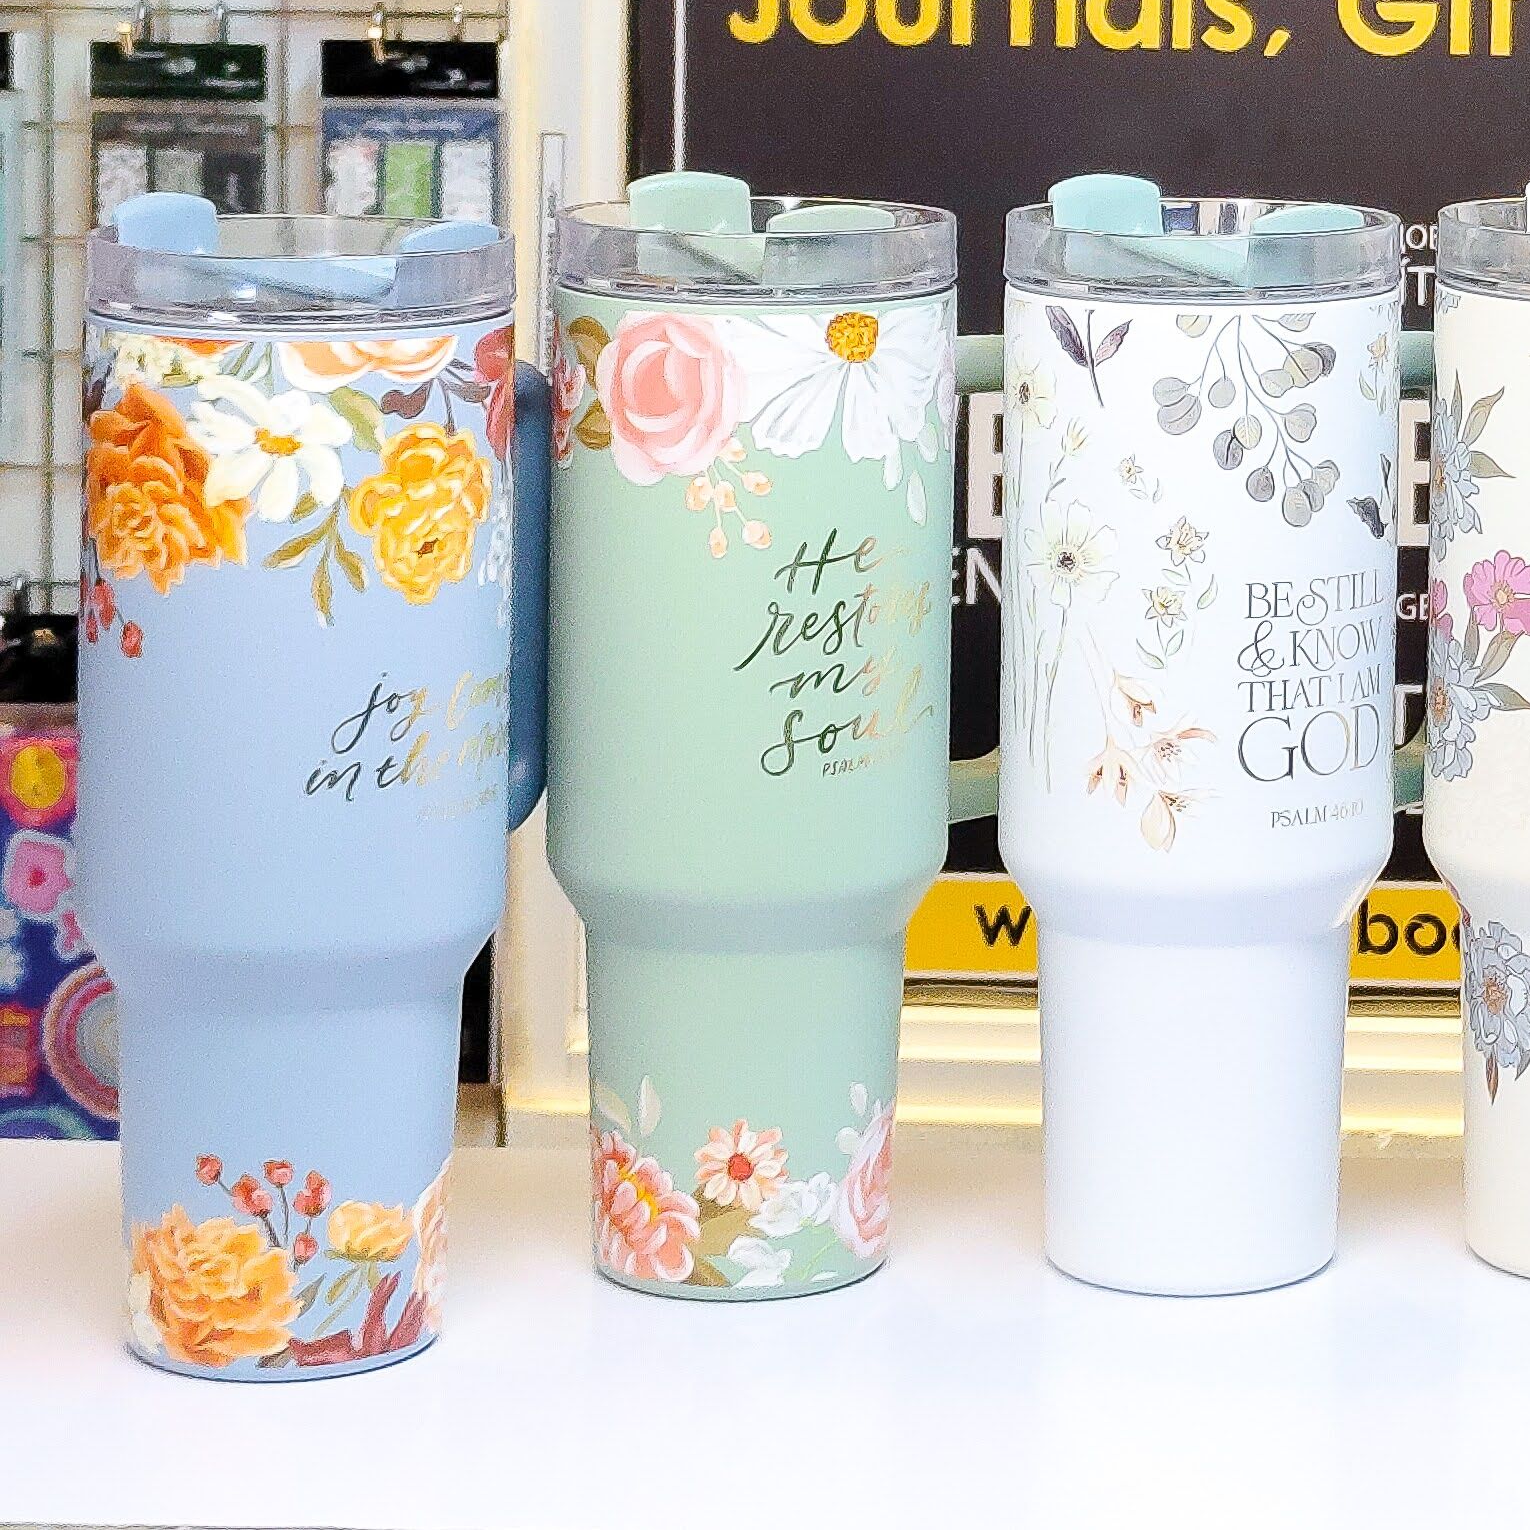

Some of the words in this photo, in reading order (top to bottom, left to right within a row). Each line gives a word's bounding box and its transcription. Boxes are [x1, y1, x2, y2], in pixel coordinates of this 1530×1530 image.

[774, 528, 912, 595] He
[1245, 581, 1294, 620] BE
[1297, 568, 1385, 627] STILL
[1237, 619, 1286, 678] &
[1290, 616, 1383, 672] KNOW
[1237, 675, 1332, 714] THAT
[1337, 673, 1347, 704] I
[1350, 663, 1382, 702] AM
[1237, 703, 1382, 783] GOD
[303, 759, 361, 803] in
[1270, 804, 1328, 829] PSALM
